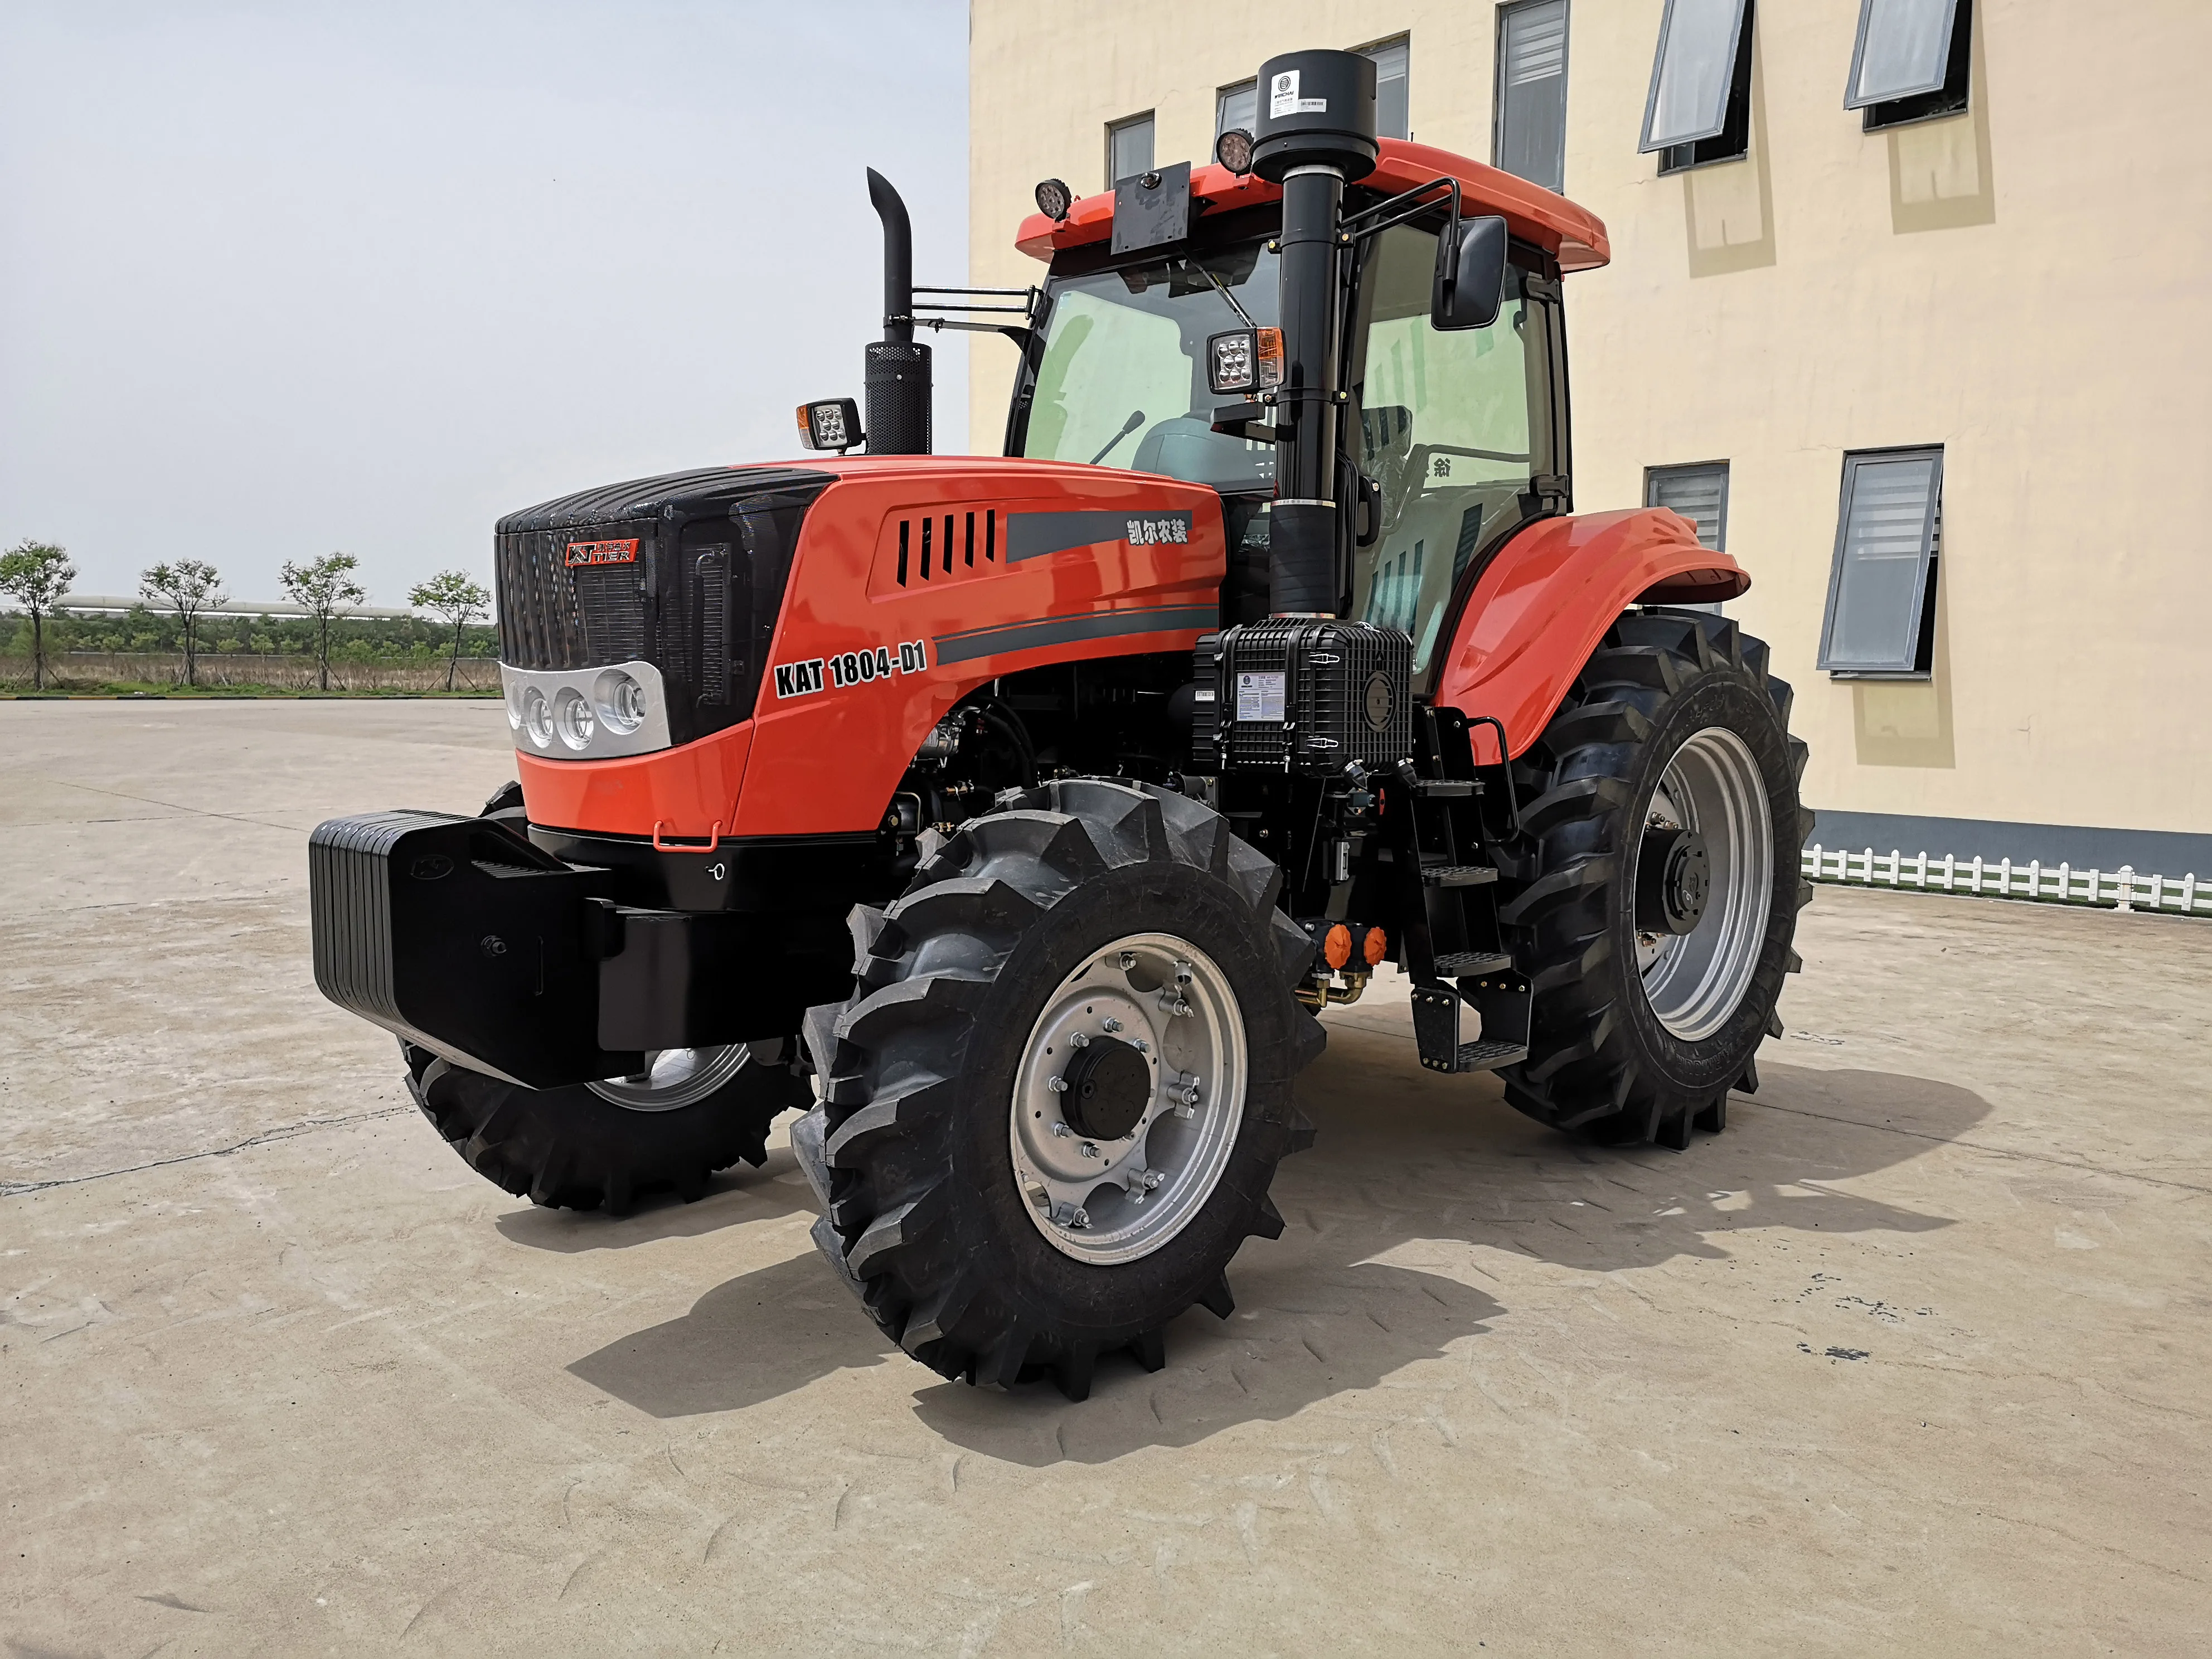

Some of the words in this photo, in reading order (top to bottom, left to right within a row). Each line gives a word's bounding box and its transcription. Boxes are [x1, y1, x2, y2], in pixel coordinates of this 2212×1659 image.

[1127, 518, 1188, 545] 凯尔农装
[593, 551, 630, 562] TIER
[774, 658, 824, 699] KAT
[828, 639, 927, 688] 1804-D1
